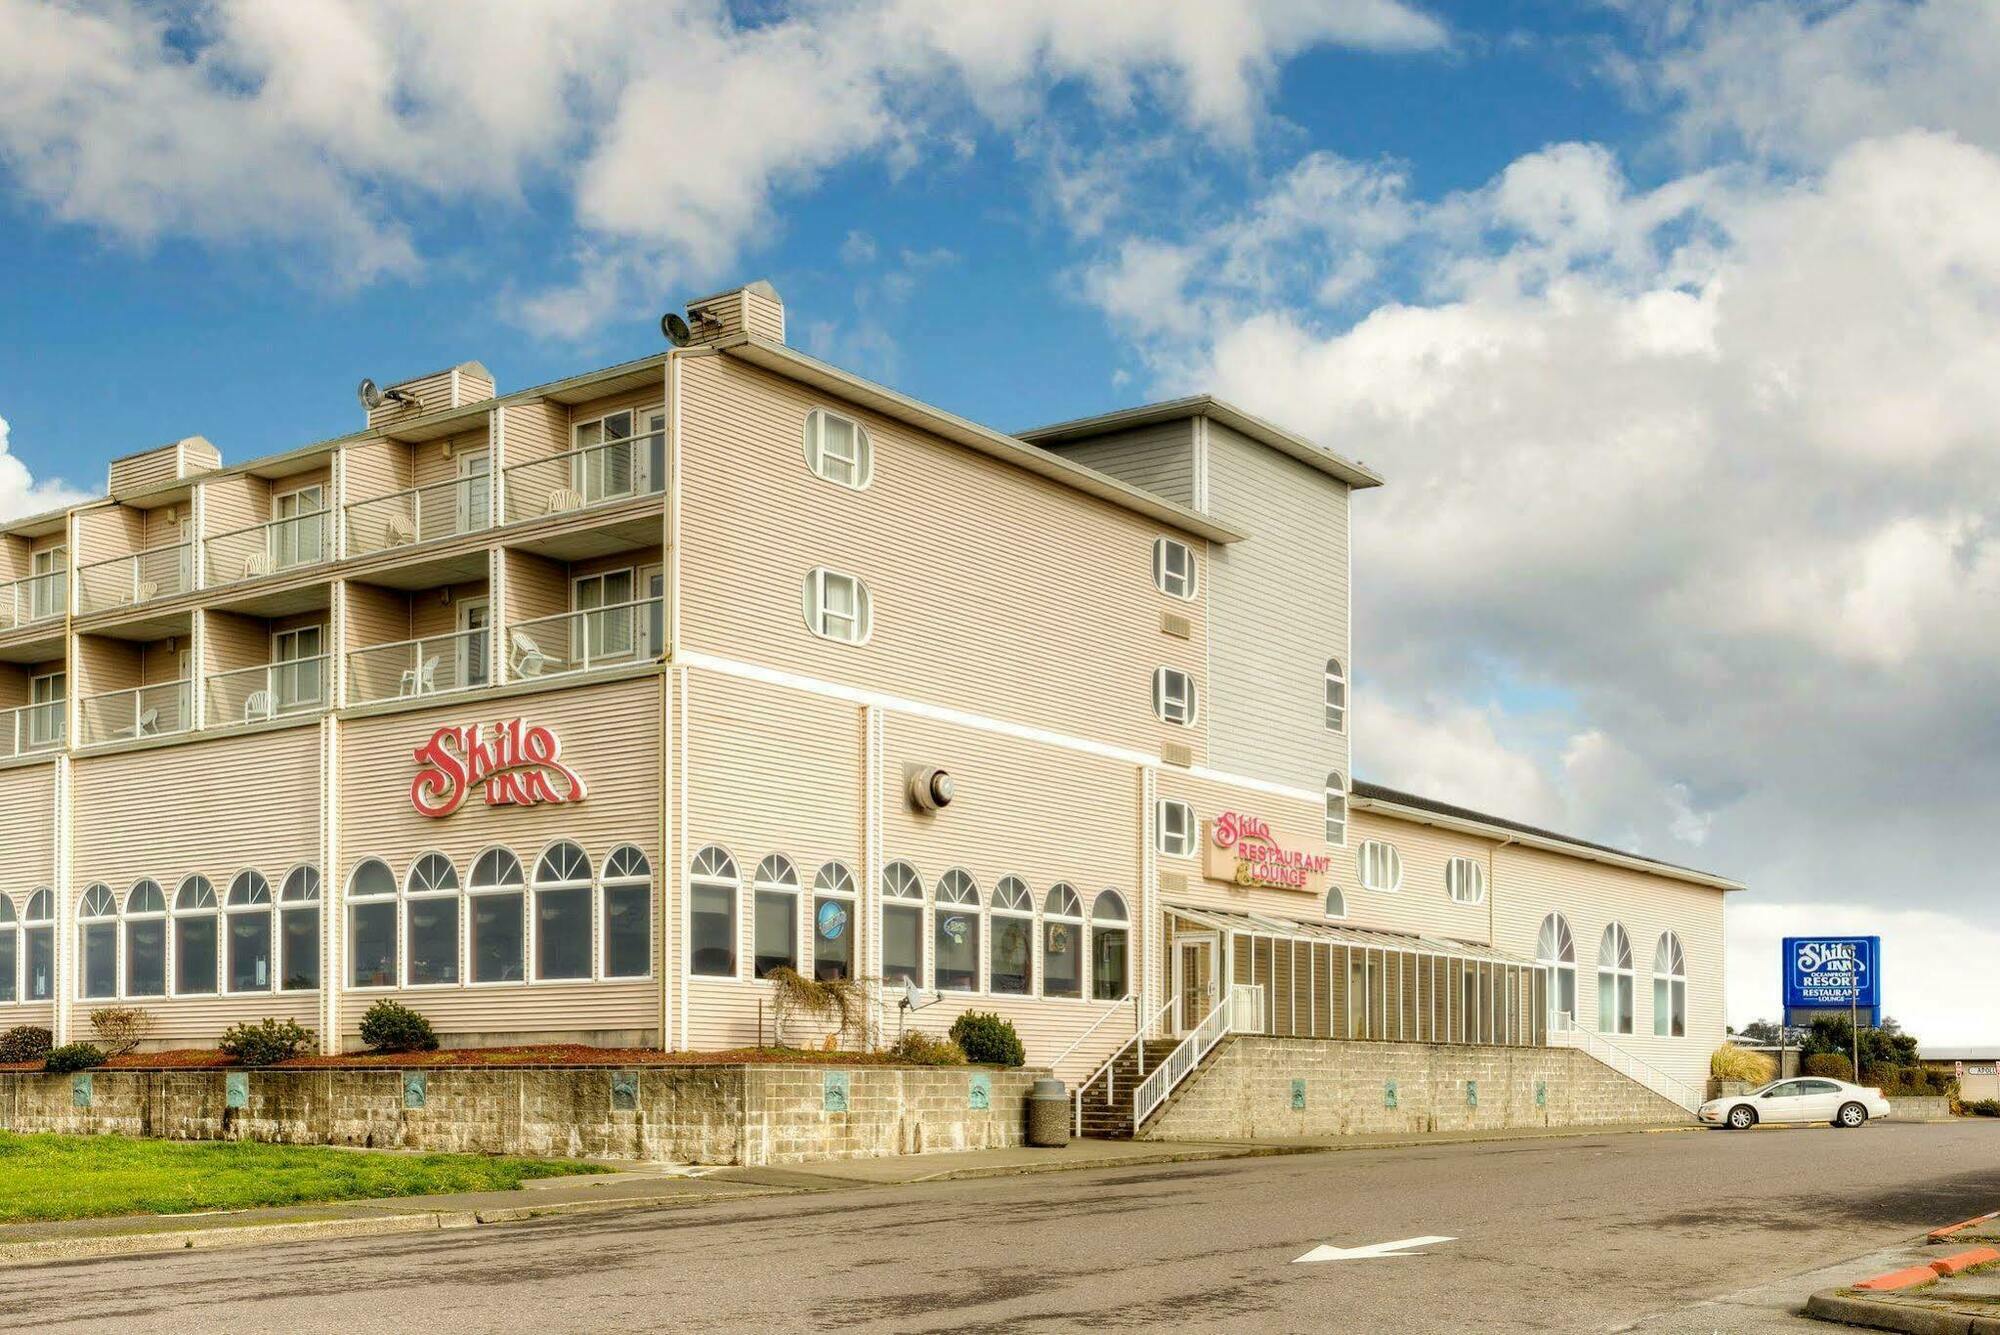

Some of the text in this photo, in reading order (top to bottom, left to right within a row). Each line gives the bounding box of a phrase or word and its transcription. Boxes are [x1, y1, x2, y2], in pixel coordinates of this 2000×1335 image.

[410, 716, 587, 818] Shilo
[1216, 811, 1281, 852] Shilo
[1238, 842, 1331, 872] RESTAURANT
[1251, 863, 1307, 885] LOUNGE
[1797, 943, 1866, 973] Shilo
[1803, 977, 1859, 987] RESORT
[1803, 988, 1860, 997] RESTAURANT
